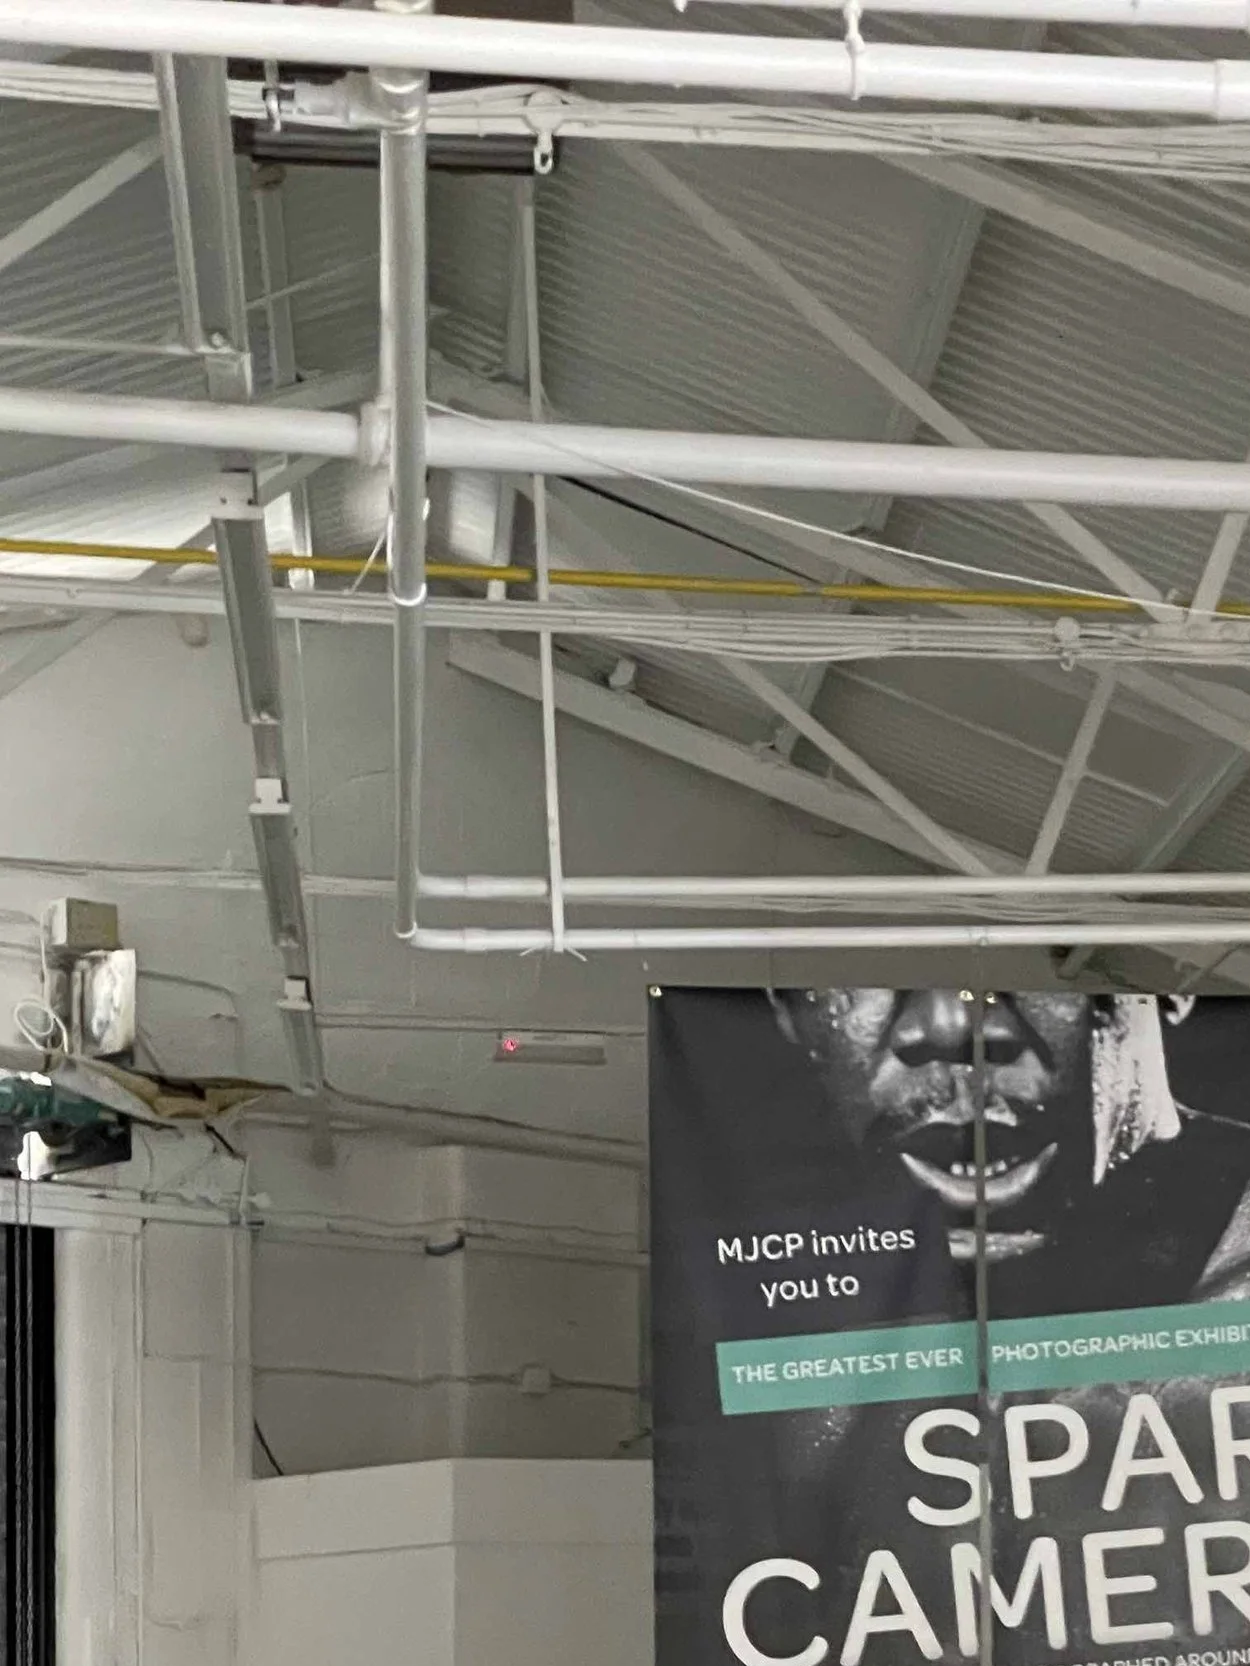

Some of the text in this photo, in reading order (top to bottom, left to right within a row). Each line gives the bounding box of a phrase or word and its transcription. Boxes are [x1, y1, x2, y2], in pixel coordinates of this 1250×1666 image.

[717, 1226, 916, 1264] MJCP invites
[760, 1273, 860, 1308] you to
[732, 1363, 778, 1383] THE
[782, 1353, 900, 1381] GREATEST
[905, 1347, 964, 1369] EVER
[991, 1331, 1170, 1362] PHOTOGRAPHIC
